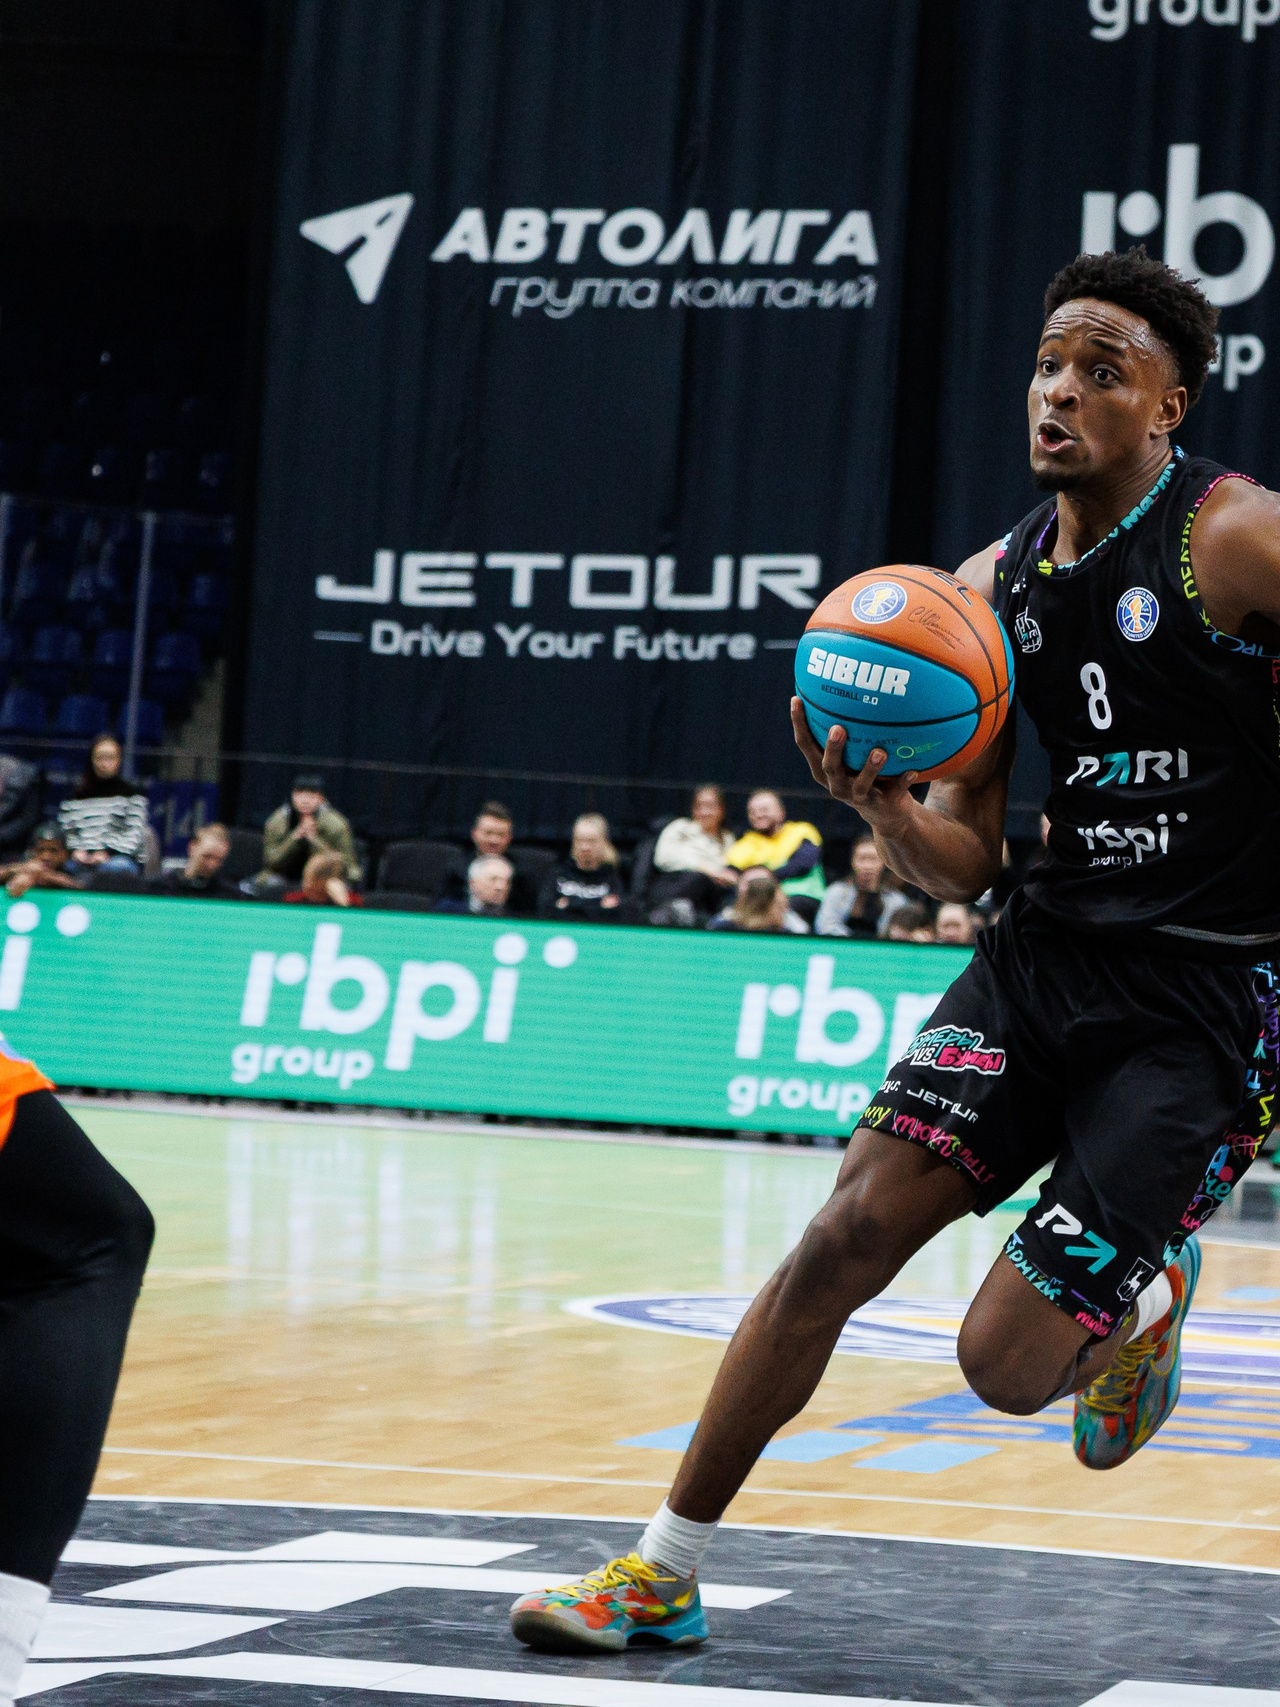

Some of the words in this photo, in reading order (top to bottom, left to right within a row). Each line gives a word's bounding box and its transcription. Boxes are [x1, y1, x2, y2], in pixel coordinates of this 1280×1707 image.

[431, 207, 879, 266] АВТОЛИГА
[489, 276, 660, 317] группа
[670, 276, 877, 312] компаний
[315, 551, 823, 611] JETOUR
[370, 623, 483, 657] Drive
[495, 624, 602, 661] Your
[613, 625, 756, 662] Future
[807, 646, 911, 697] SIBUR
[1079, 662, 1113, 730] 8
[862, 694, 879, 706] 2.0
[1065, 747, 1189, 788] PARI
[1077, 812, 1188, 864] rbpi
[240, 922, 579, 1071] rbpi
[230, 1041, 373, 1090] group
[727, 1075, 873, 1123] group
